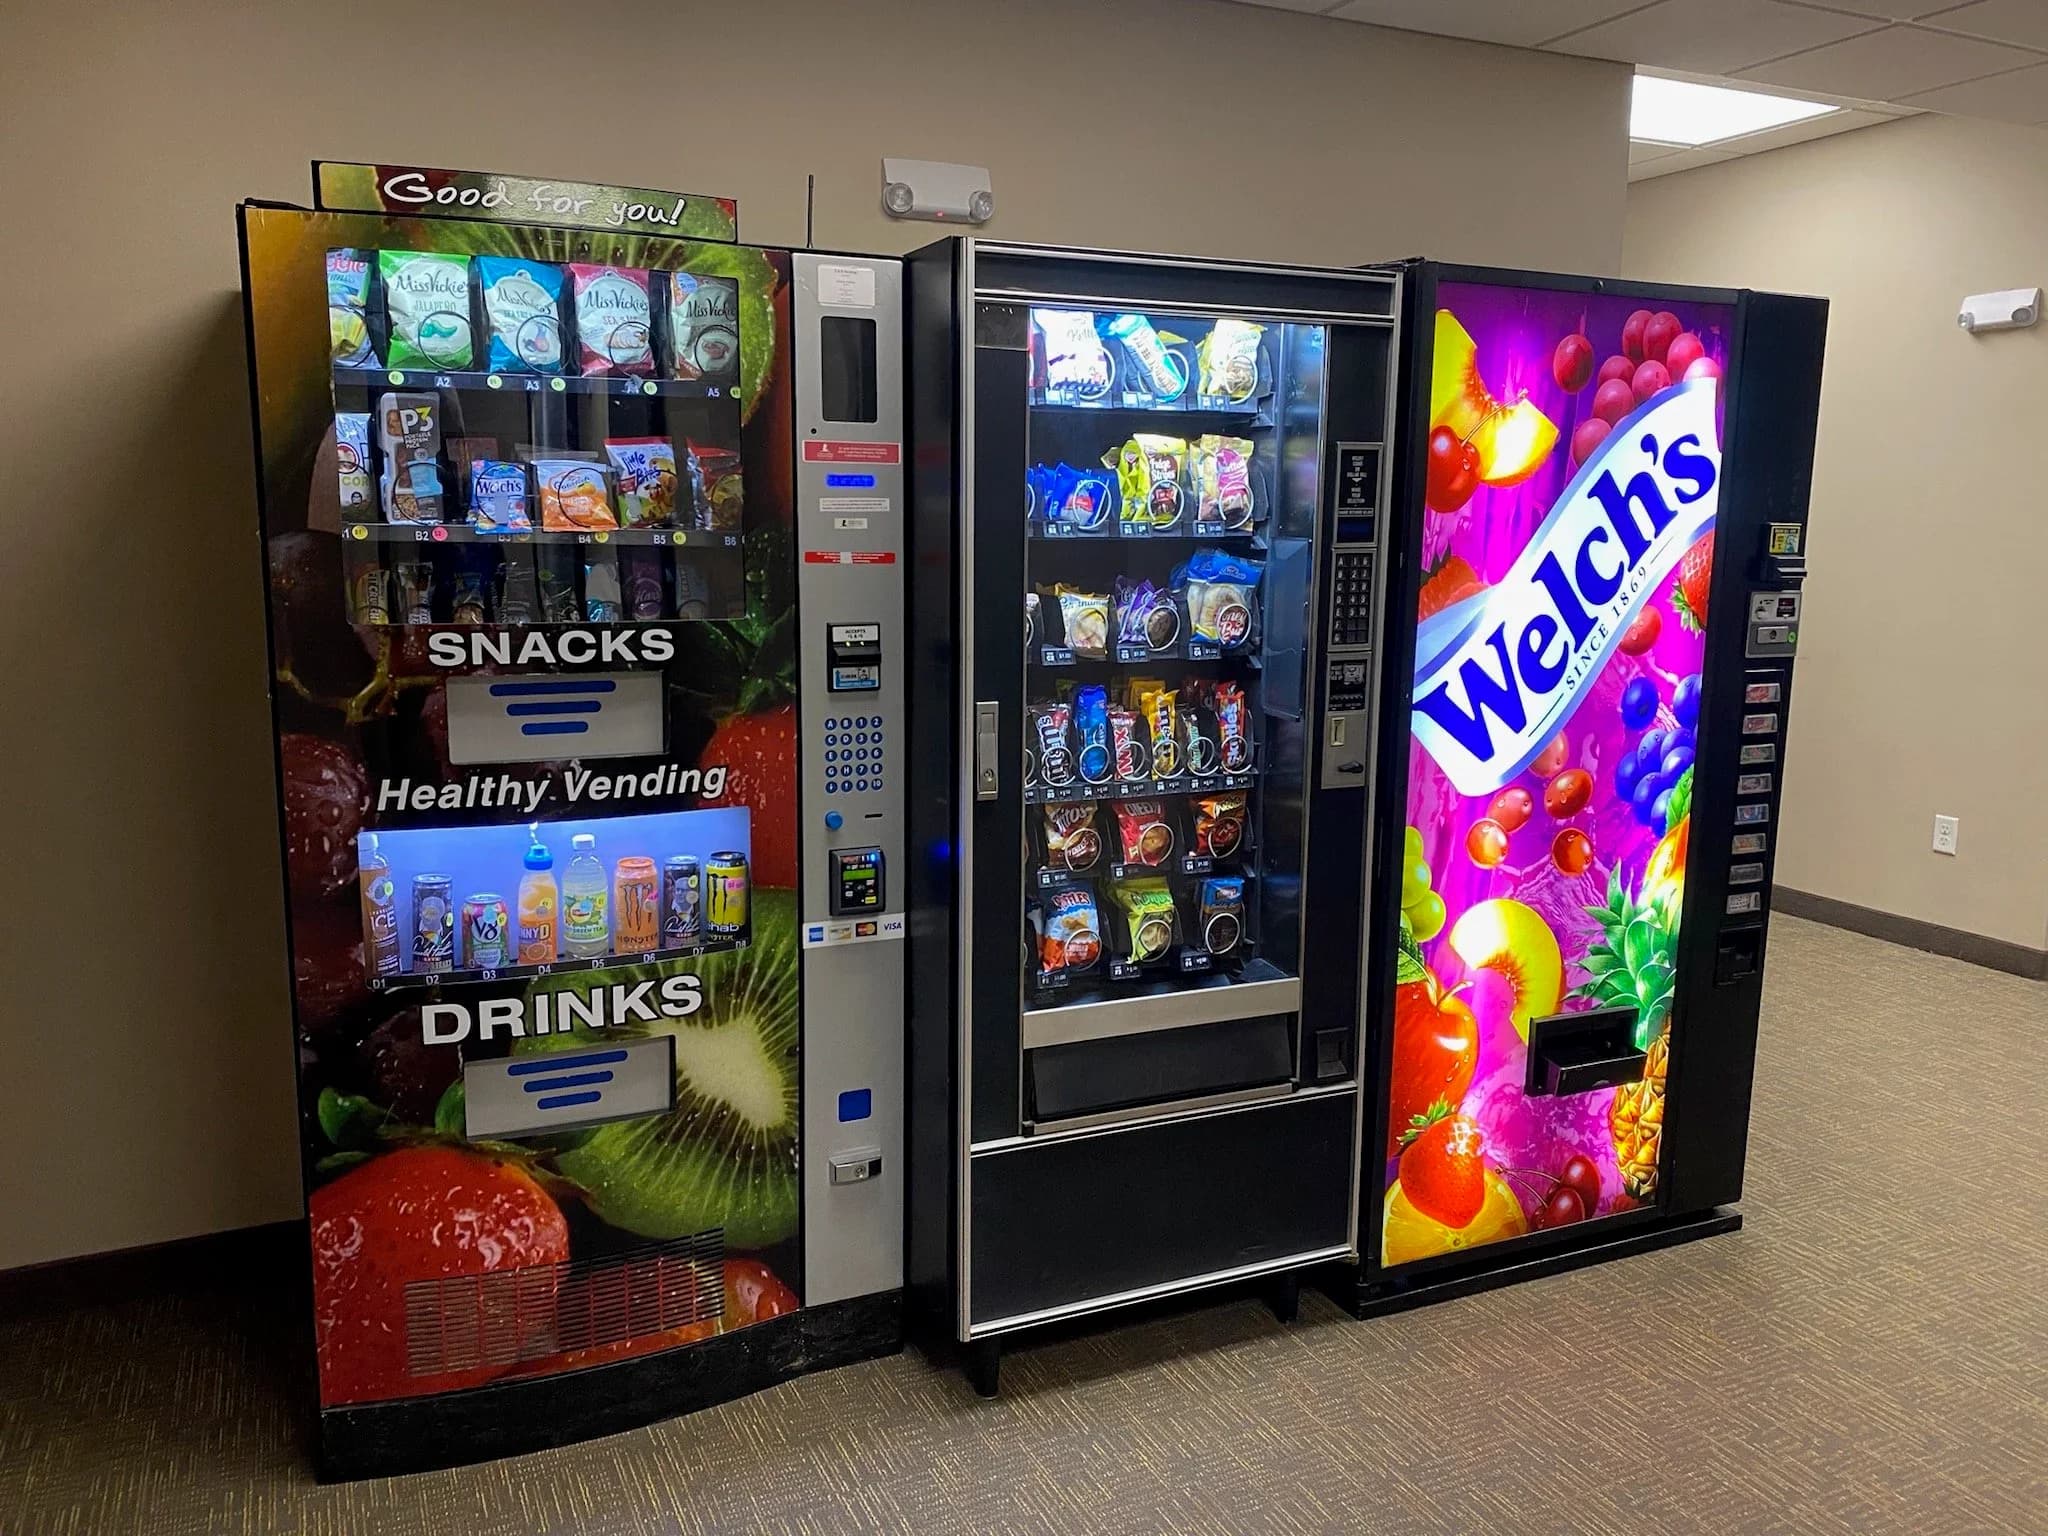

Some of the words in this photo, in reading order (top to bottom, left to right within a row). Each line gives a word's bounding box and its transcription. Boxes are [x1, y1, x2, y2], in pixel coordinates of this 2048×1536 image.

[384, 173, 514, 207] Good
[528, 186, 595, 217] for
[607, 197, 686, 227] you!
[584, 290, 612, 309] Miss
[436, 376, 451, 387] A2
[526, 382, 540, 391] A3
[707, 388, 721, 398] A5
[400, 406, 434, 434] P3
[621, 451, 646, 476] Little
[635, 465, 661, 486] Bites
[415, 530, 429, 541] B2
[578, 534, 592, 544] B4
[653, 535, 666, 545] B5
[724, 536, 737, 546] B6
[1413, 433, 1716, 762] Welch's
[1566, 622, 1609, 692] SINCE
[1611, 564, 1648, 619] 1869
[427, 629, 676, 668] SNACKS
[1226, 702, 1239, 766] Skittles
[1114, 727, 1134, 776] TWIX
[376, 774, 550, 813] Healthy
[563, 765, 728, 801] Vending
[1049, 806, 1088, 835] Fritos
[370, 910, 397, 931] ICE
[883, 922, 902, 931] VISA
[473, 916, 498, 940] V8
[735, 940, 747, 950] D8
[692, 946, 705, 957] D7
[591, 958, 605, 969] D5
[643, 953, 656, 964] D6
[482, 969, 497, 981] D3
[537, 965, 552, 976] D4
[372, 978, 386, 990] D1
[425, 975, 440, 986] D2
[421, 974, 704, 1046] DRINKS
